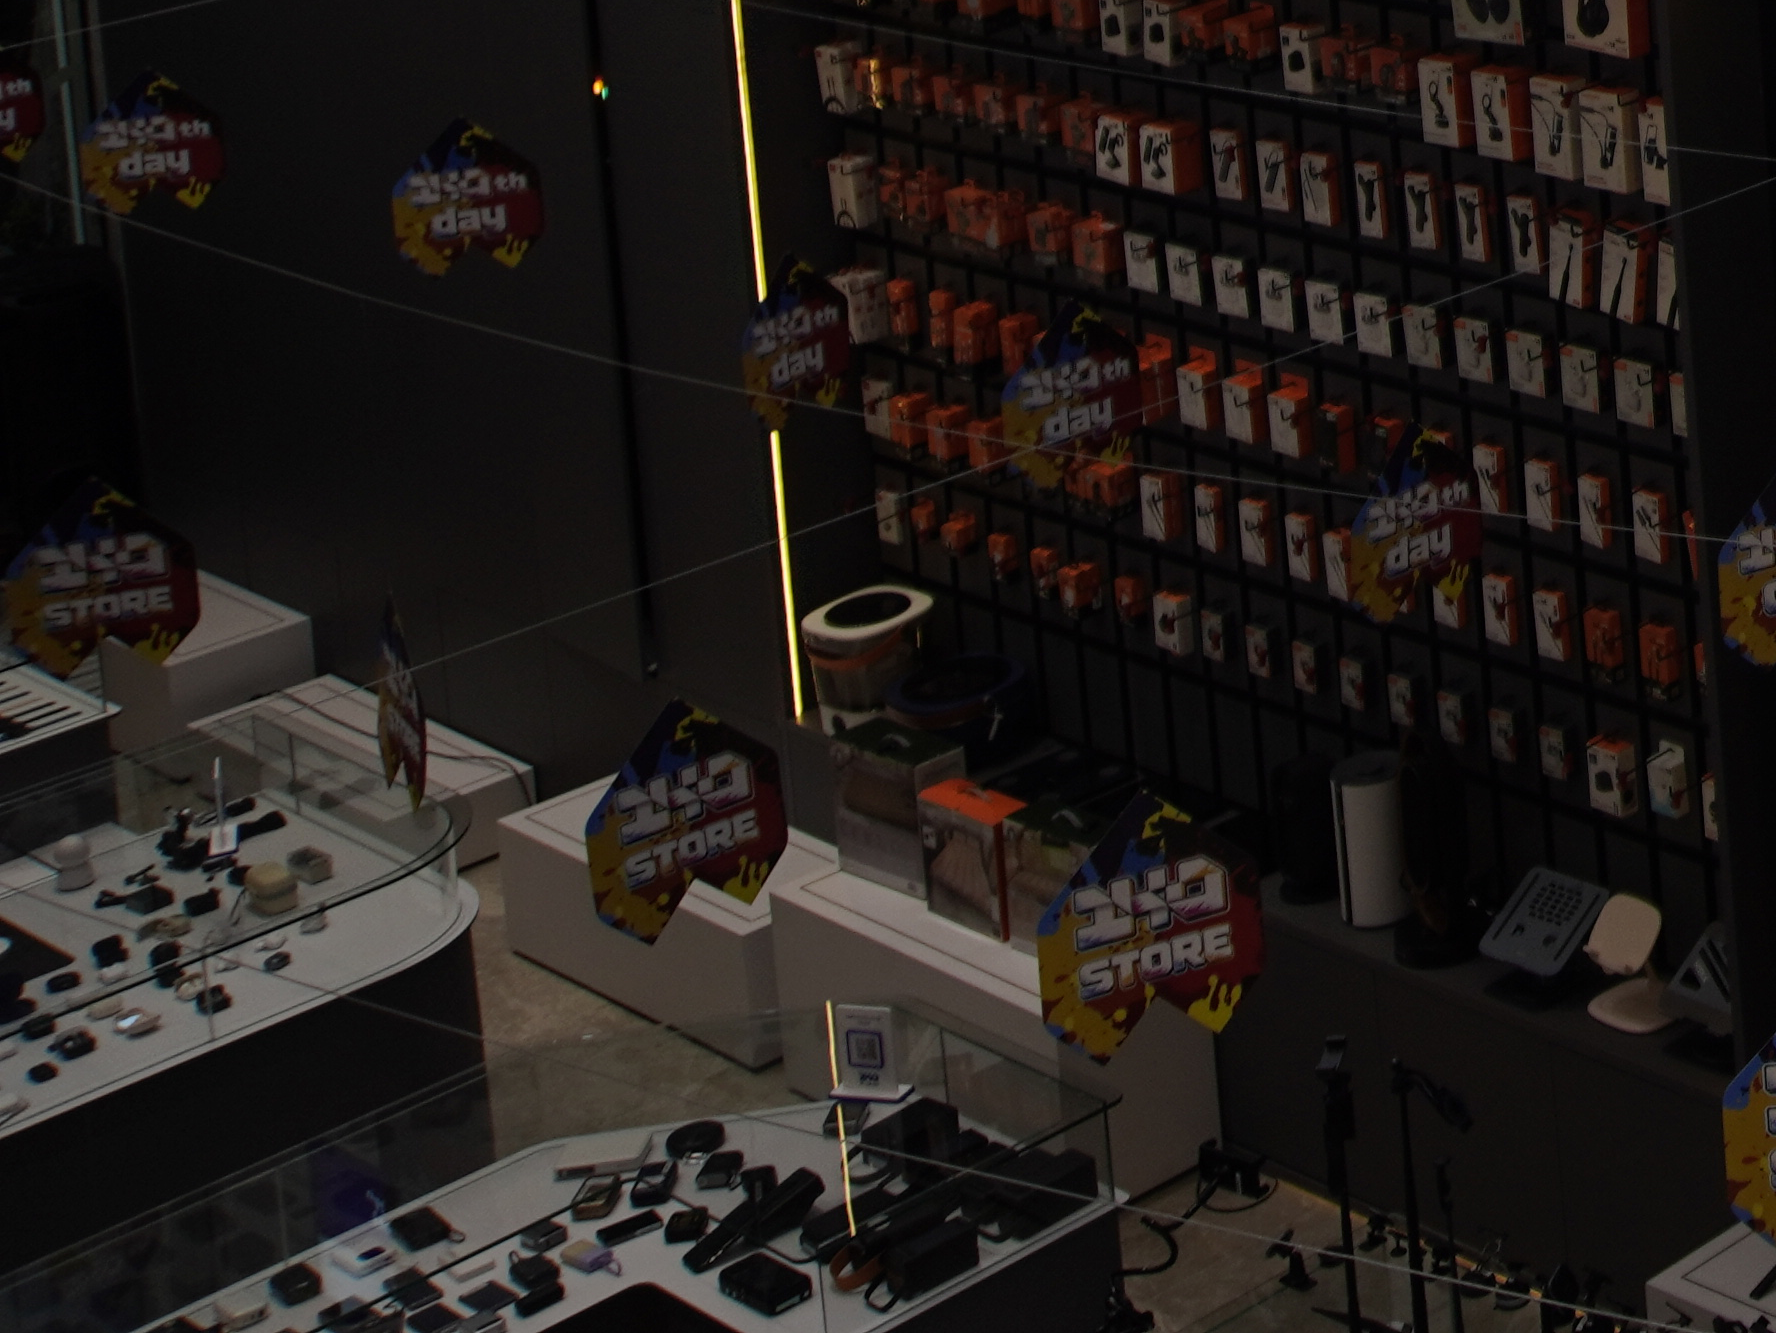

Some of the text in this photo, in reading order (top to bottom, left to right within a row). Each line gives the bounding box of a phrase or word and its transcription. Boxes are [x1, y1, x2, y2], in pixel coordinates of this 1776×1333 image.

[117, 147, 193, 182] day
[430, 202, 508, 238] day
[769, 343, 825, 388] day
[1043, 396, 1115, 450] day
[1382, 522, 1453, 580] day
[42, 588, 174, 630] STORE
[621, 807, 763, 893] STORE
[1075, 923, 1234, 1003] STORE
